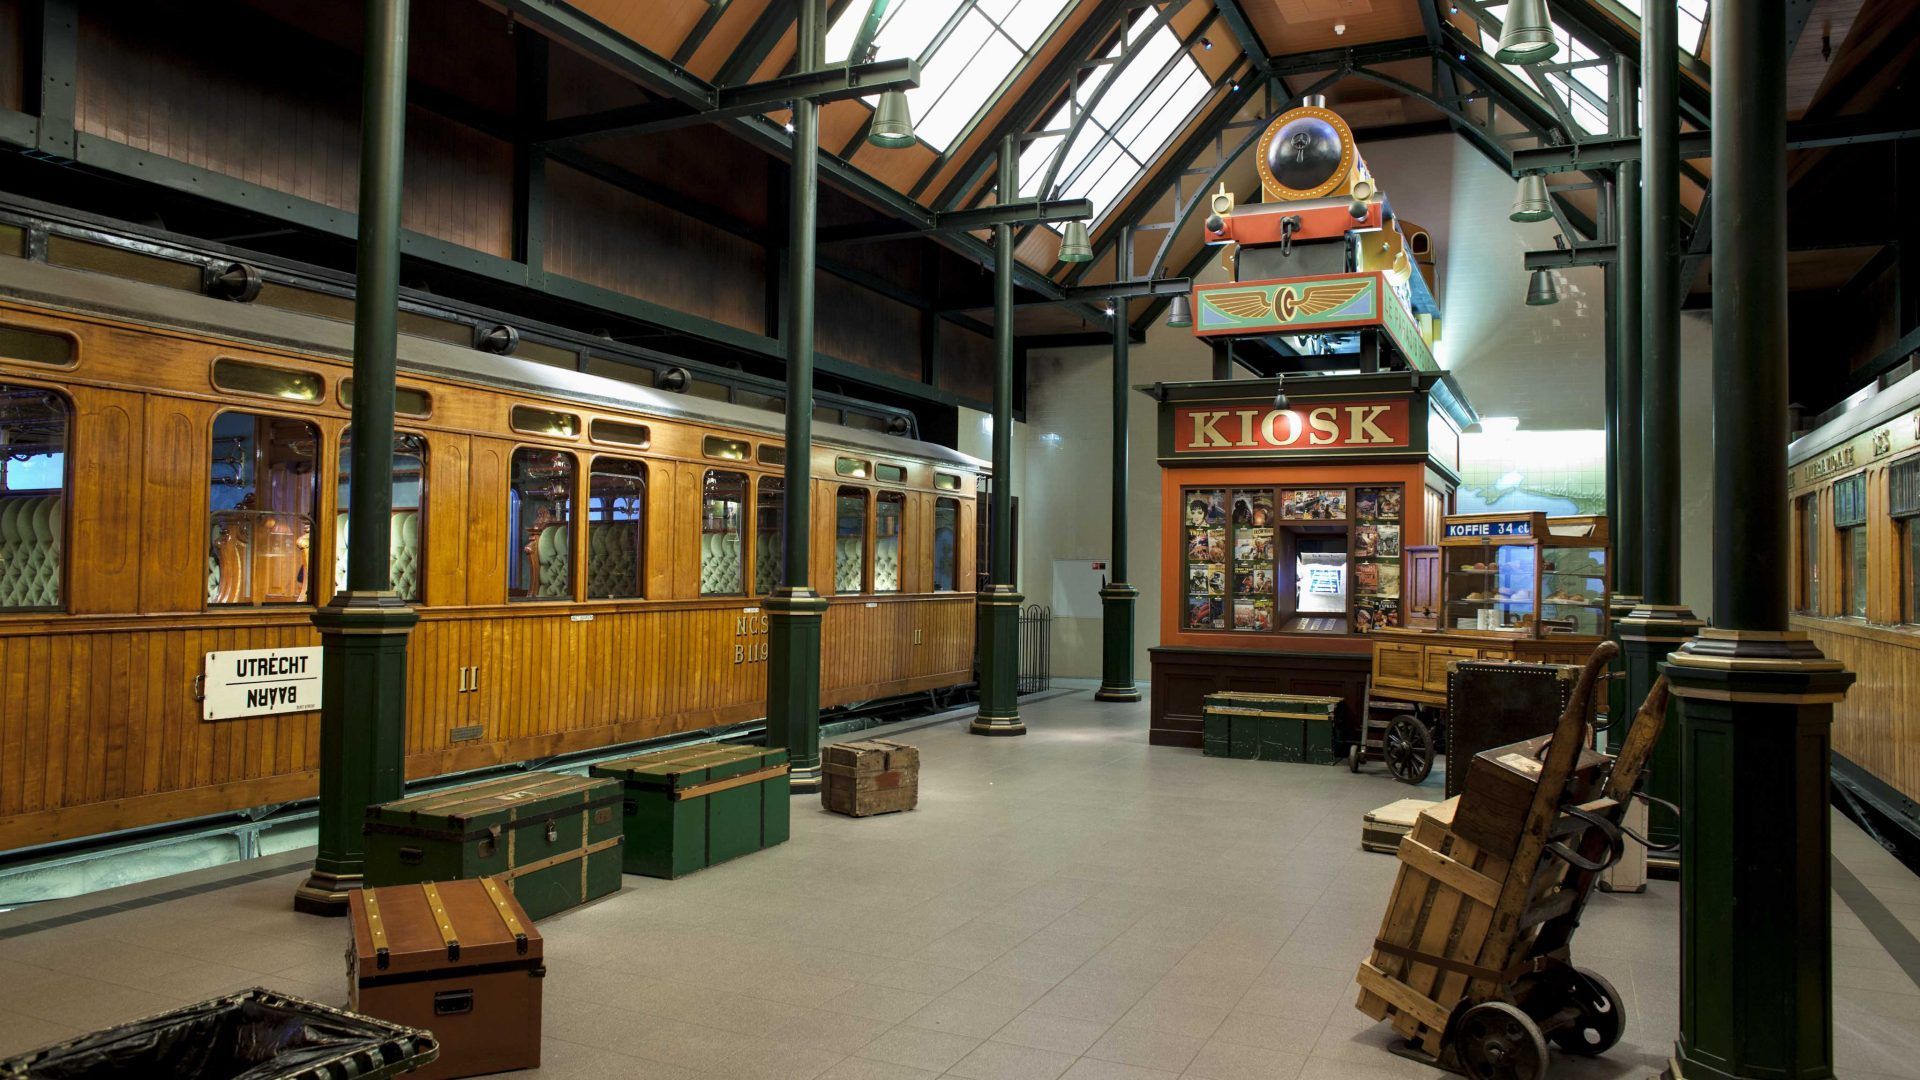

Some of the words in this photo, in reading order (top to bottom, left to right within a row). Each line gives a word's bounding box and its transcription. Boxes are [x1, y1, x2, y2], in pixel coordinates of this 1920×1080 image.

[1188, 405, 1394, 448] KIOSK
[1449, 523, 1489, 537] KOFFIE
[1498, 522, 1513, 535] 34
[1517, 523, 1530, 534] ct
[736, 616, 768, 636] NCS
